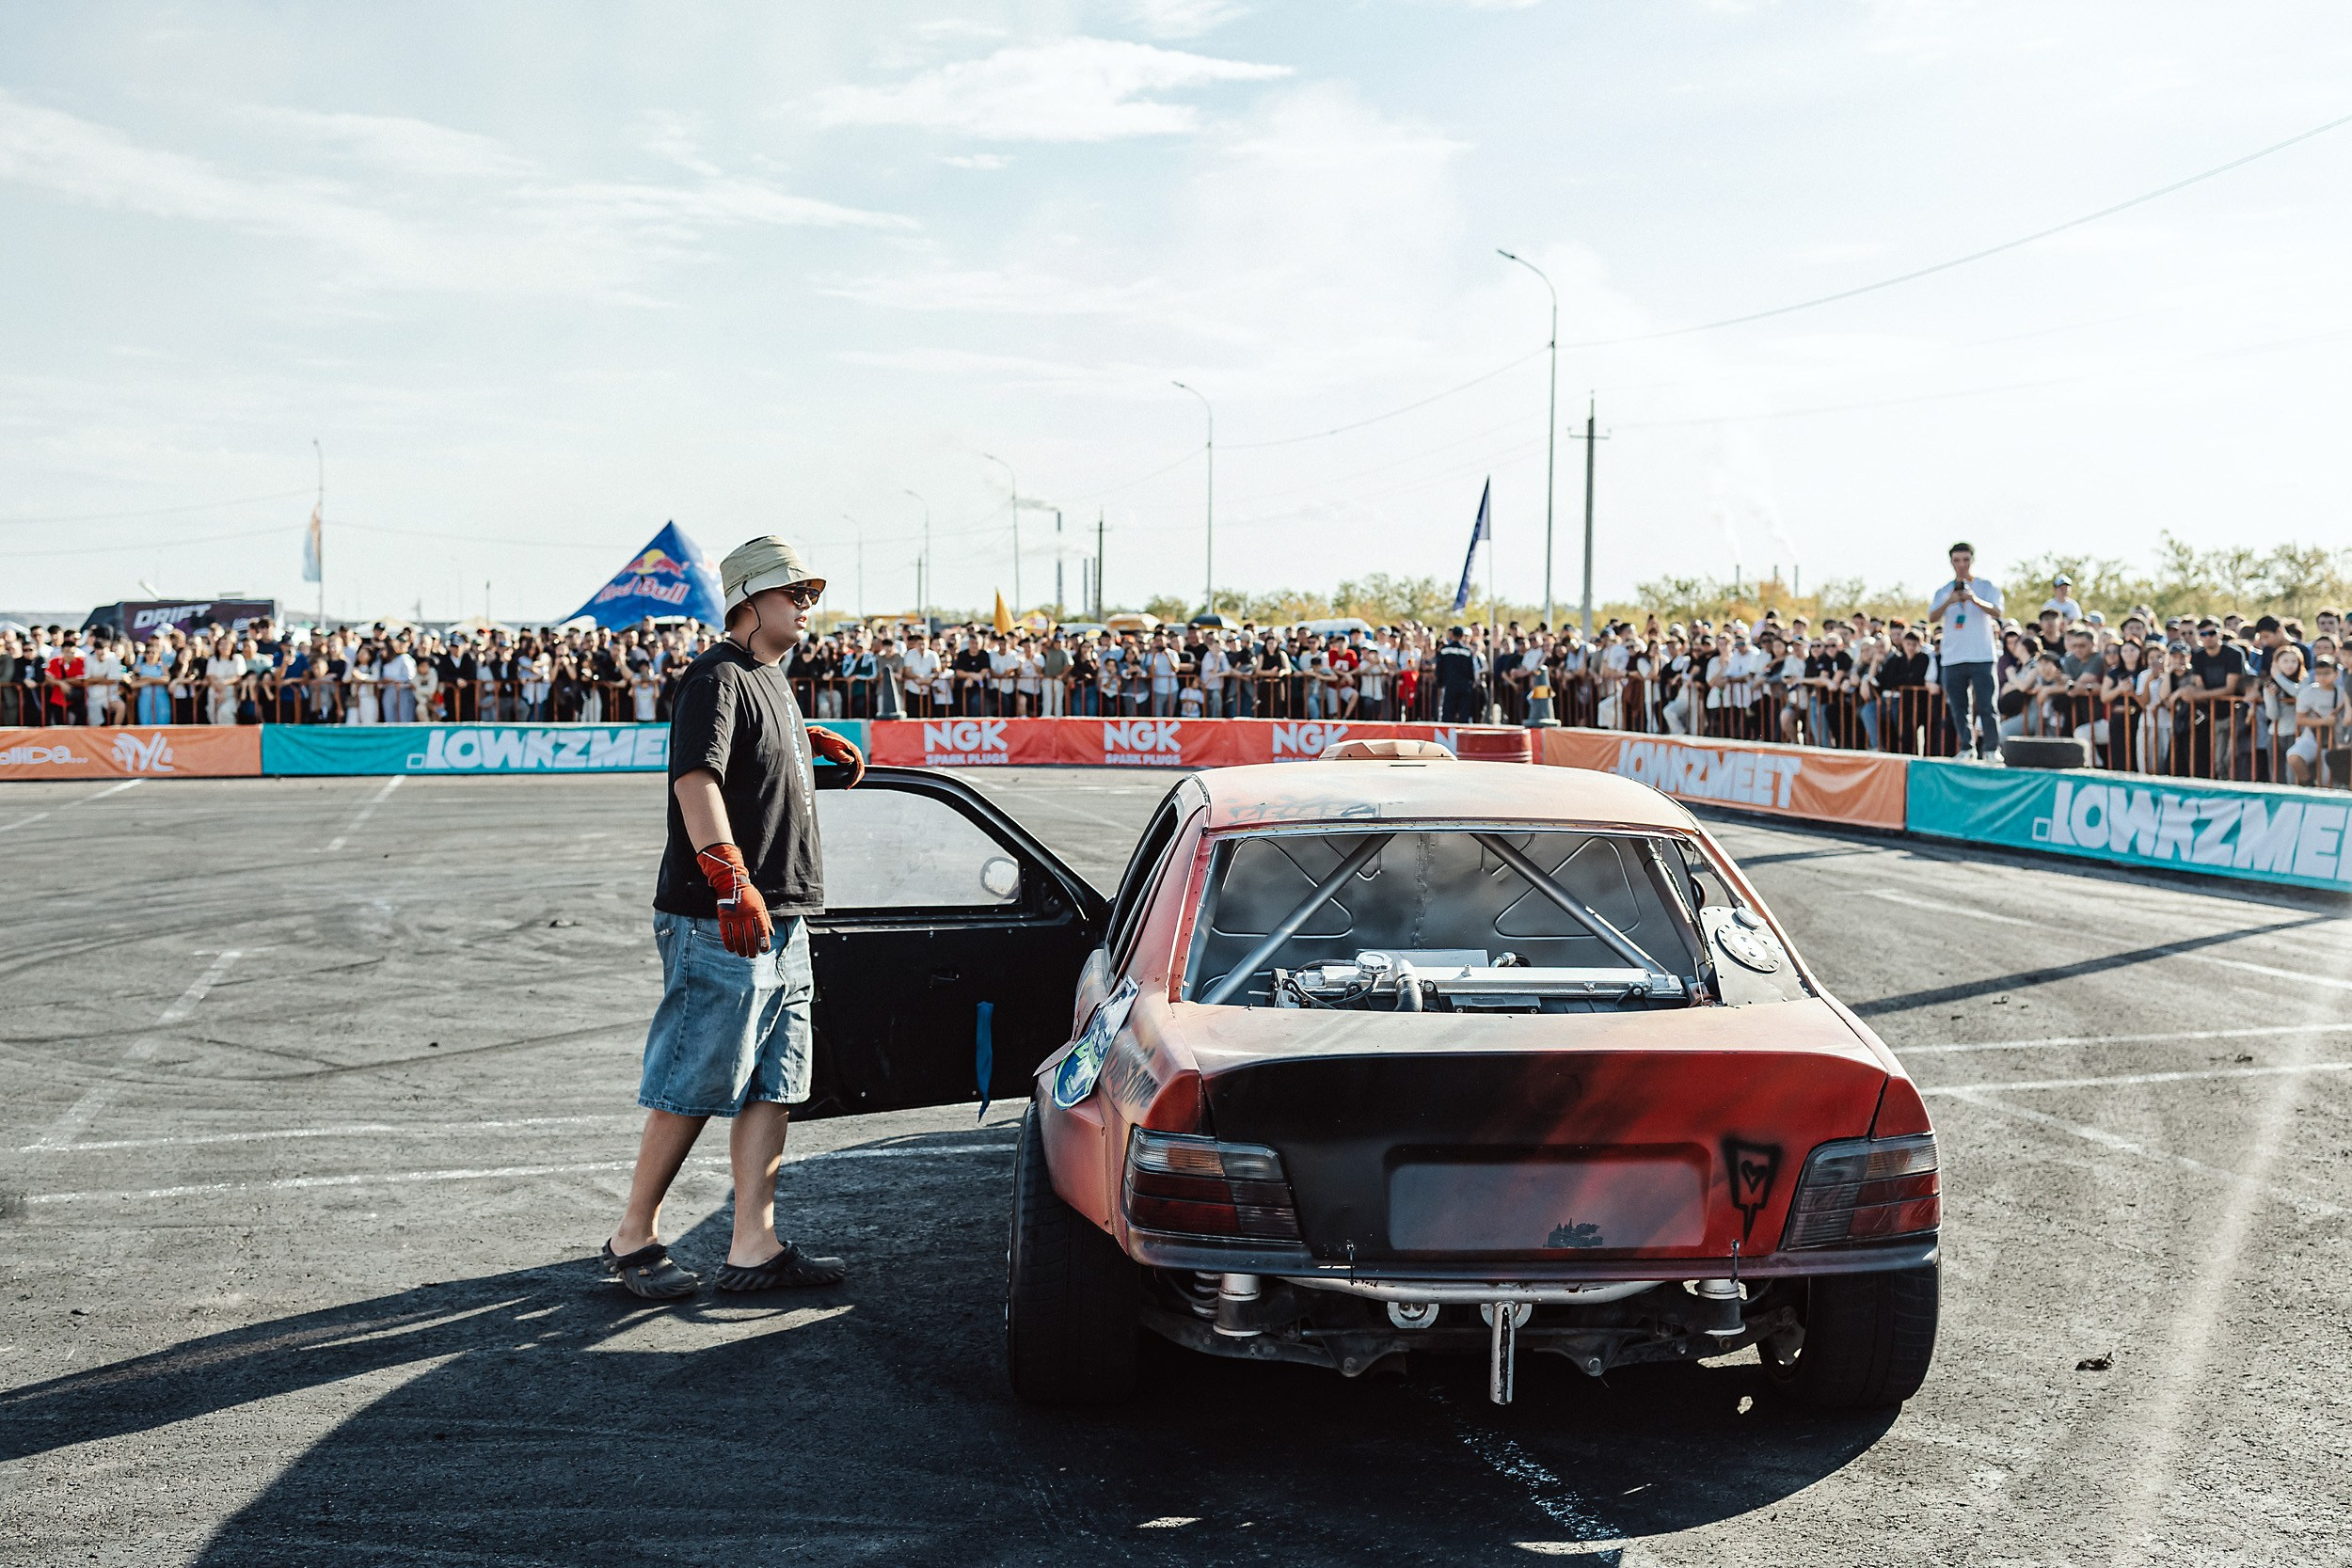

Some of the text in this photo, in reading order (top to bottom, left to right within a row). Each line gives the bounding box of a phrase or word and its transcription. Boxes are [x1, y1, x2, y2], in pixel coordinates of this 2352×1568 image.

[633, 576, 691, 606] Bull
[133, 603, 212, 629] DRIFT
[425, 727, 670, 769] LOWKZME
[923, 719, 1009, 752] NGK
[1104, 721, 1182, 752] NGK
[1272, 722, 1349, 754] NGK
